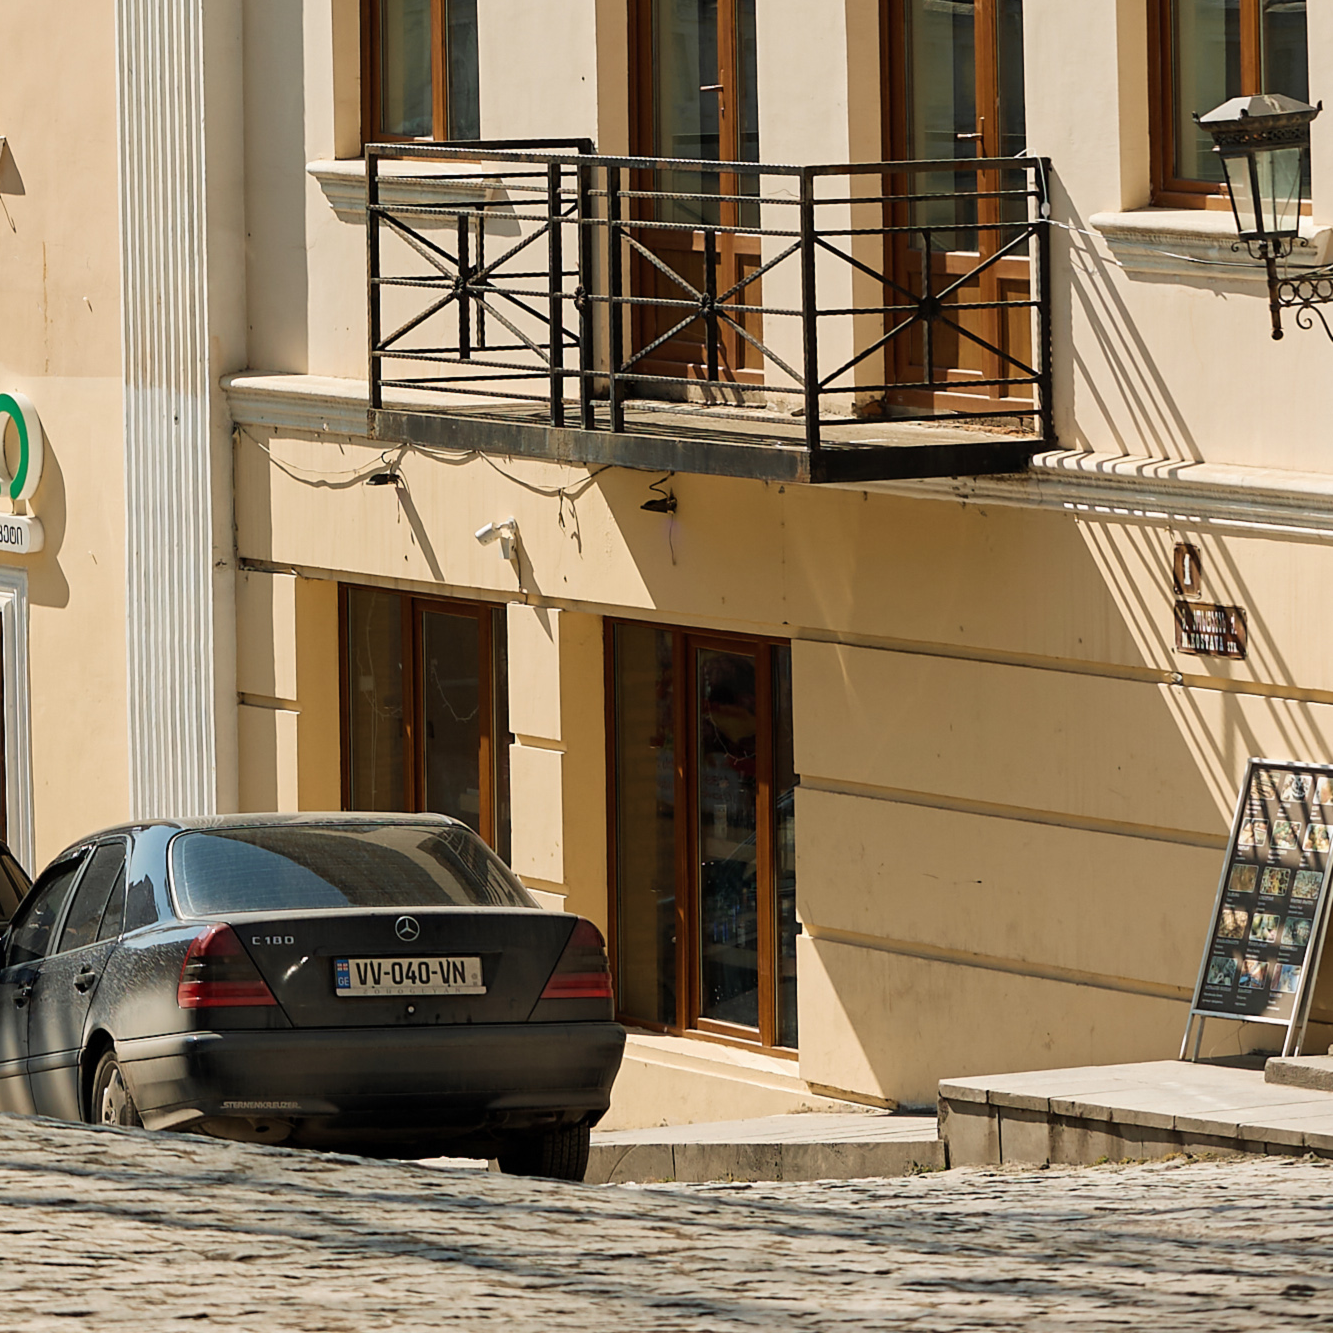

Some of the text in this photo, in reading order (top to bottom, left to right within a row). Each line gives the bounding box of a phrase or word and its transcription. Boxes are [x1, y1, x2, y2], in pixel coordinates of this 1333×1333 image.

[1183, 553, 1192, 583] 1
[264, 935, 295, 945] 180
[337, 976, 350, 987] GE
[355, 960, 467, 986] VV-040-VN
